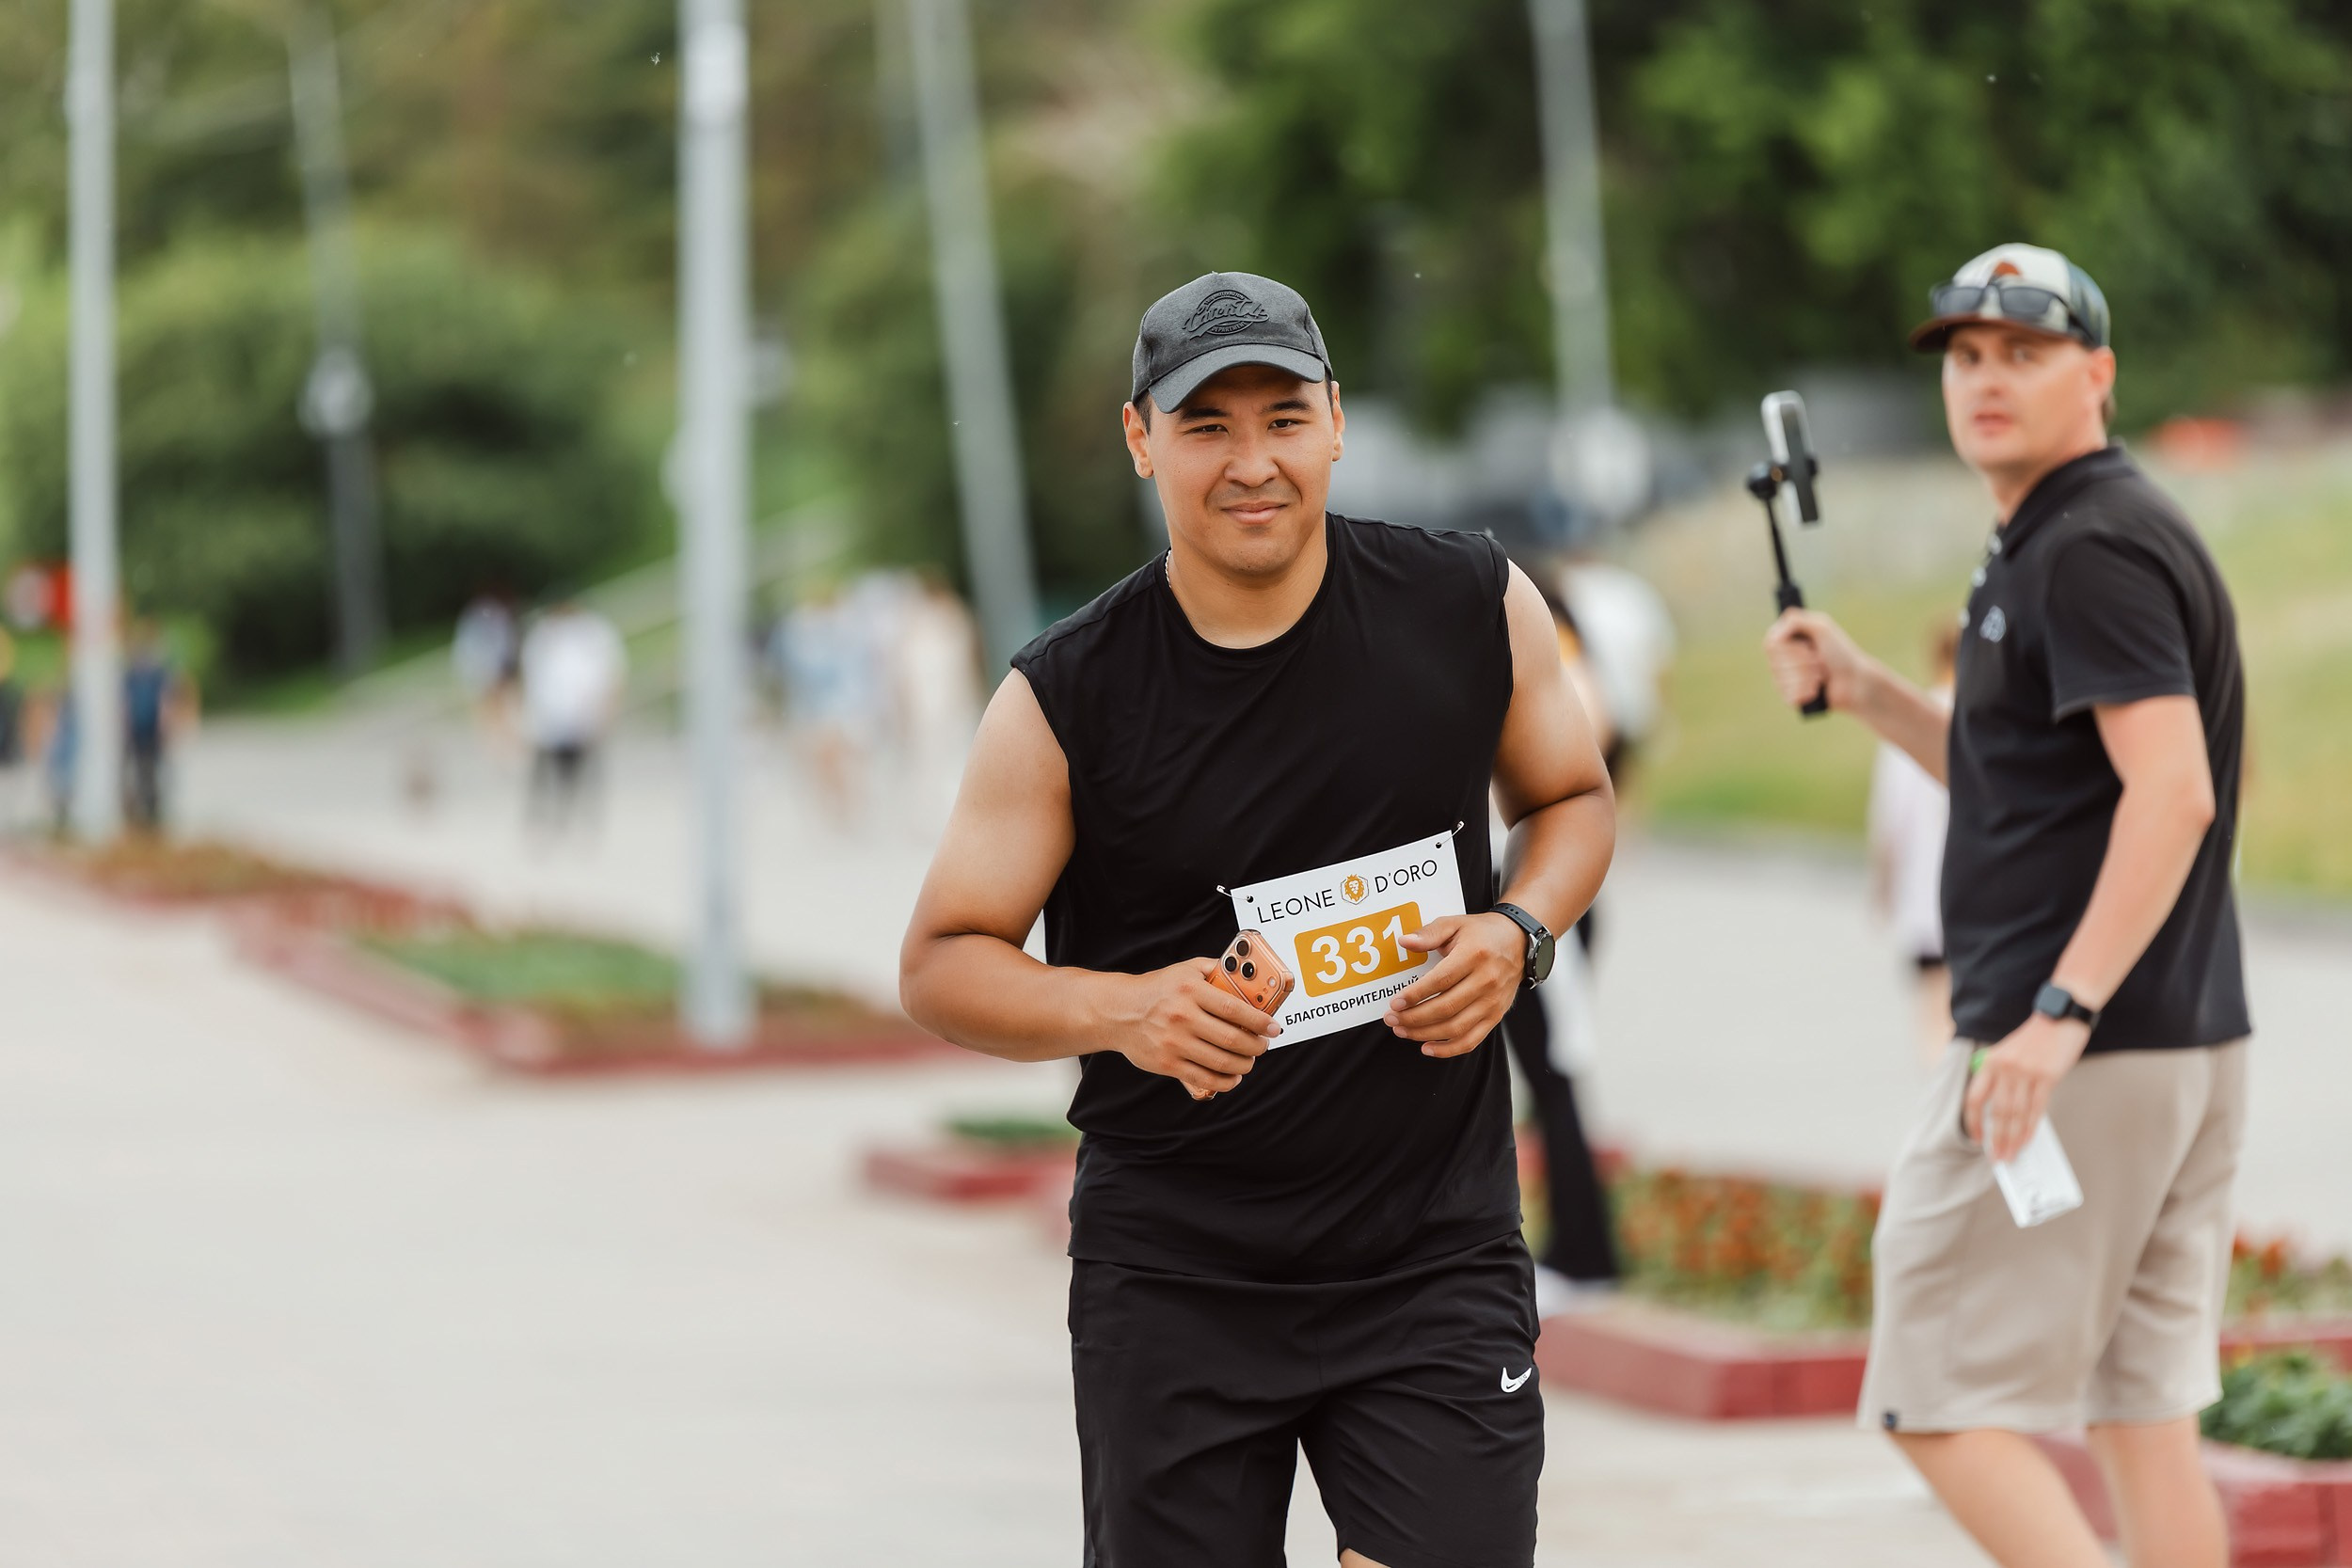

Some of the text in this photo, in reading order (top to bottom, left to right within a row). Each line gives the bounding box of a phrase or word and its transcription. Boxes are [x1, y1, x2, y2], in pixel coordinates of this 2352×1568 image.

[1257, 859, 1438, 924] LEONE D'ORO
[1311, 914, 1409, 984] 331
